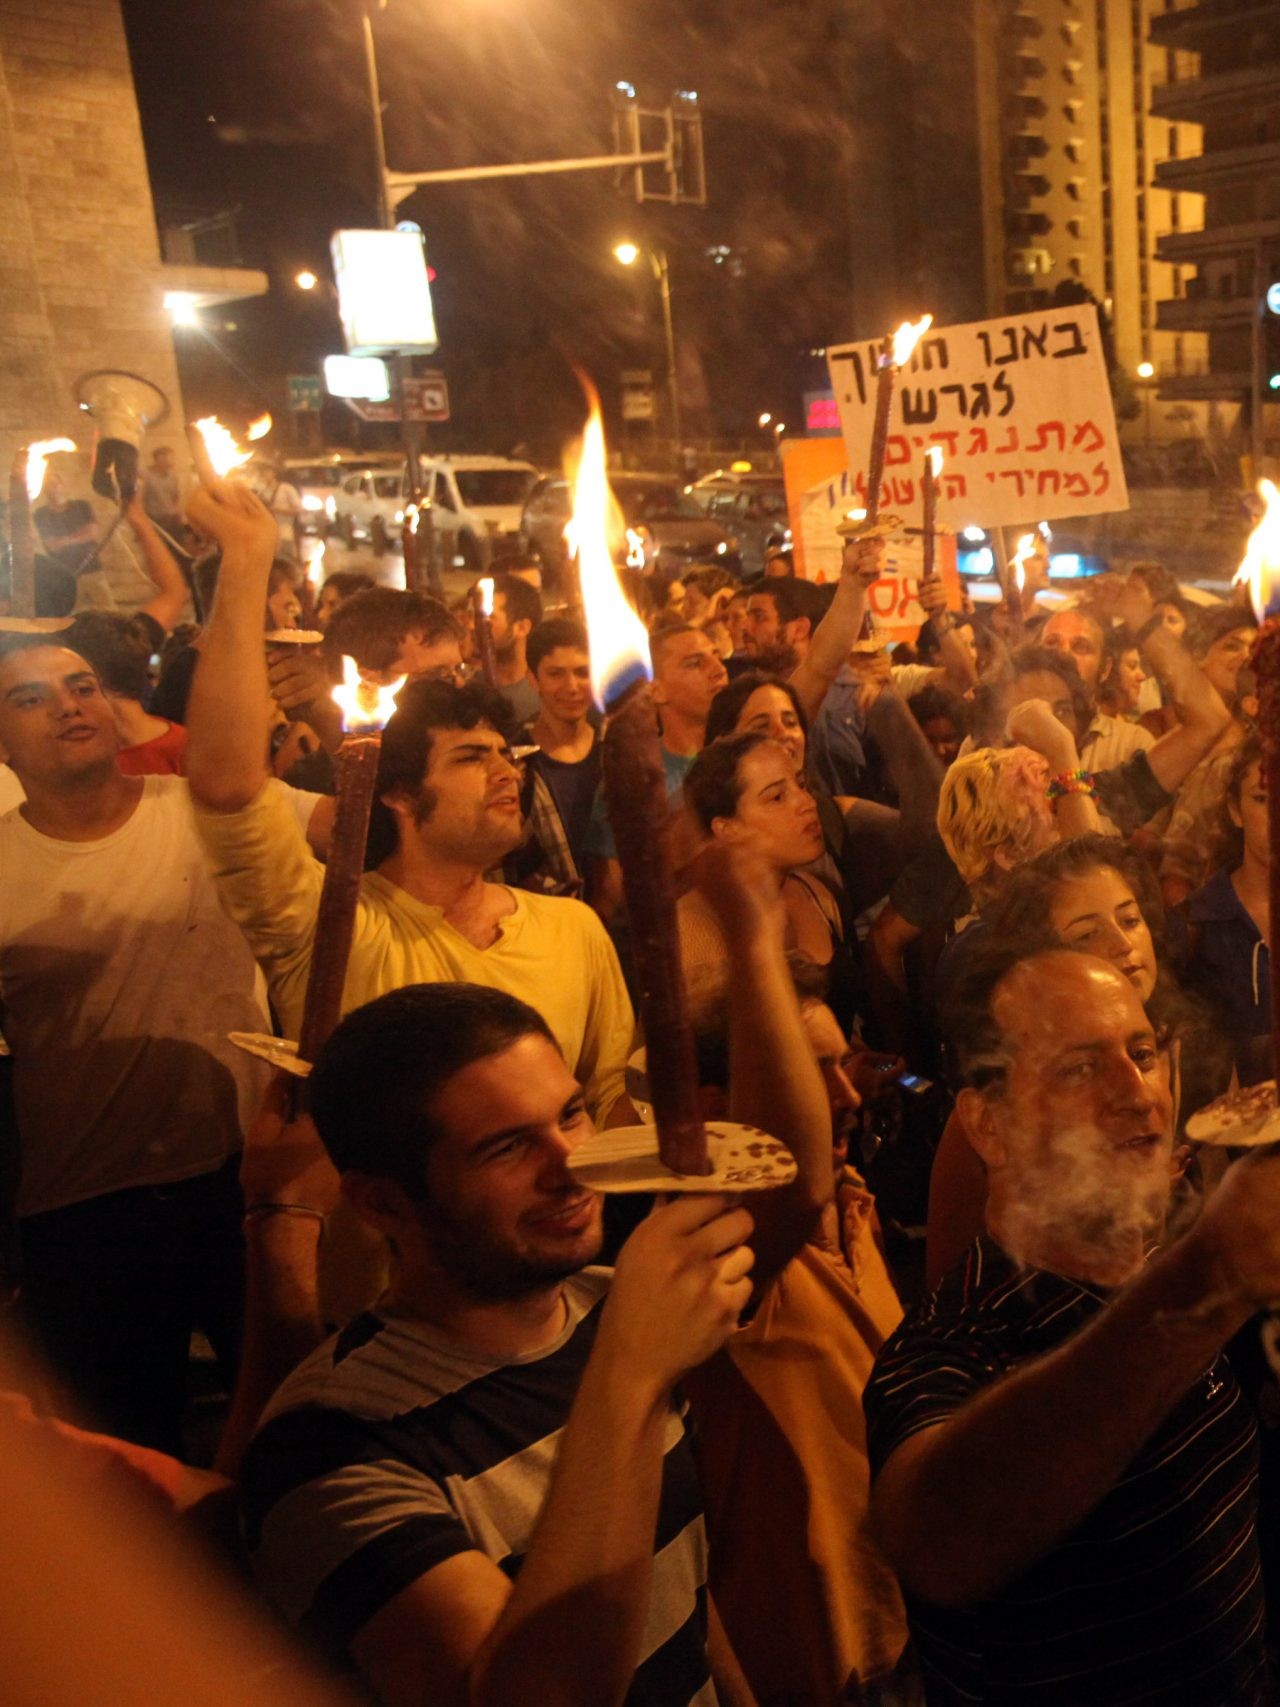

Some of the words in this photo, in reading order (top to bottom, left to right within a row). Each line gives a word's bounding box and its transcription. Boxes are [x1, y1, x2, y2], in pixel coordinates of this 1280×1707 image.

[977, 321, 1088, 368] באנו
[901, 370, 1015, 425] לגרש
[885, 420, 1105, 467] מתנגדים
[986, 461, 1110, 497] למחירי
